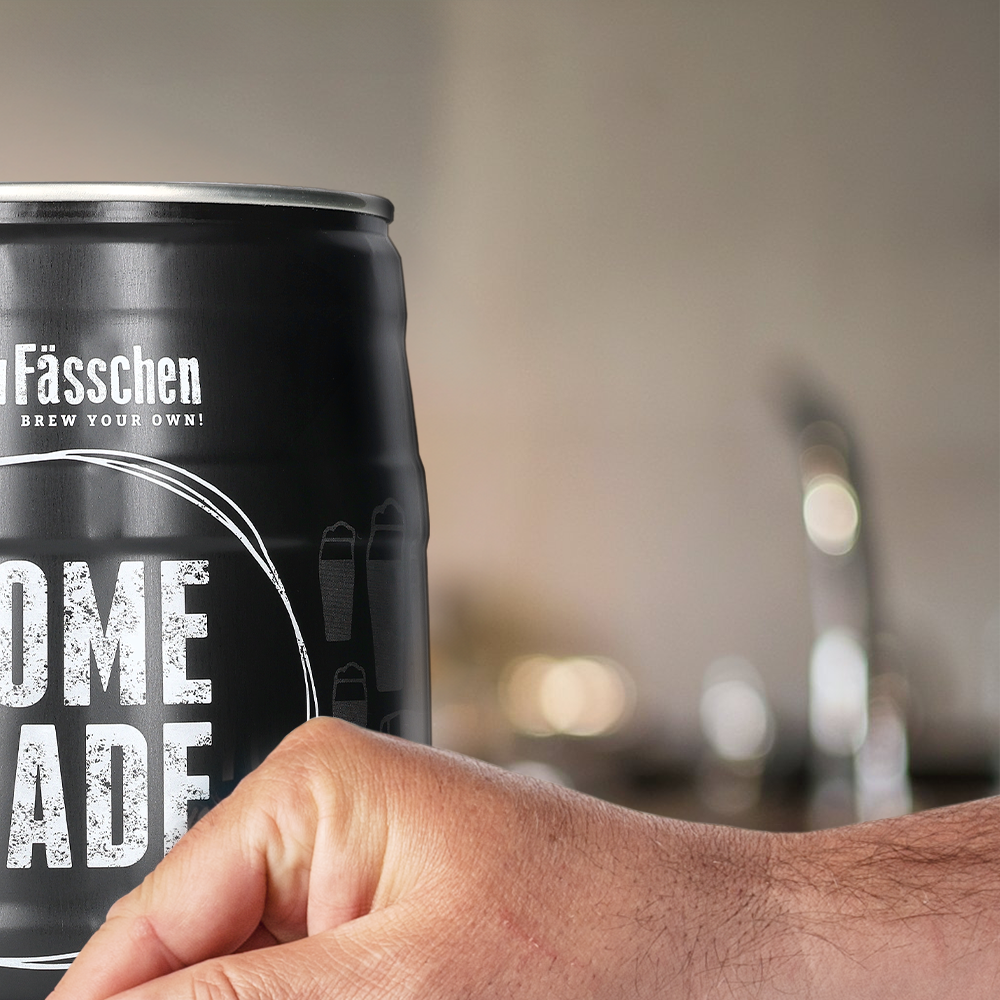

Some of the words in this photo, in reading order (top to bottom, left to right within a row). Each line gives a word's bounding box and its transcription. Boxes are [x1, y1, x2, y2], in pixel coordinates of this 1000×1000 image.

[21, 413, 77, 427] BREW
[88, 413, 143, 427] YOUR
[151, 412, 204, 427] OWN!
